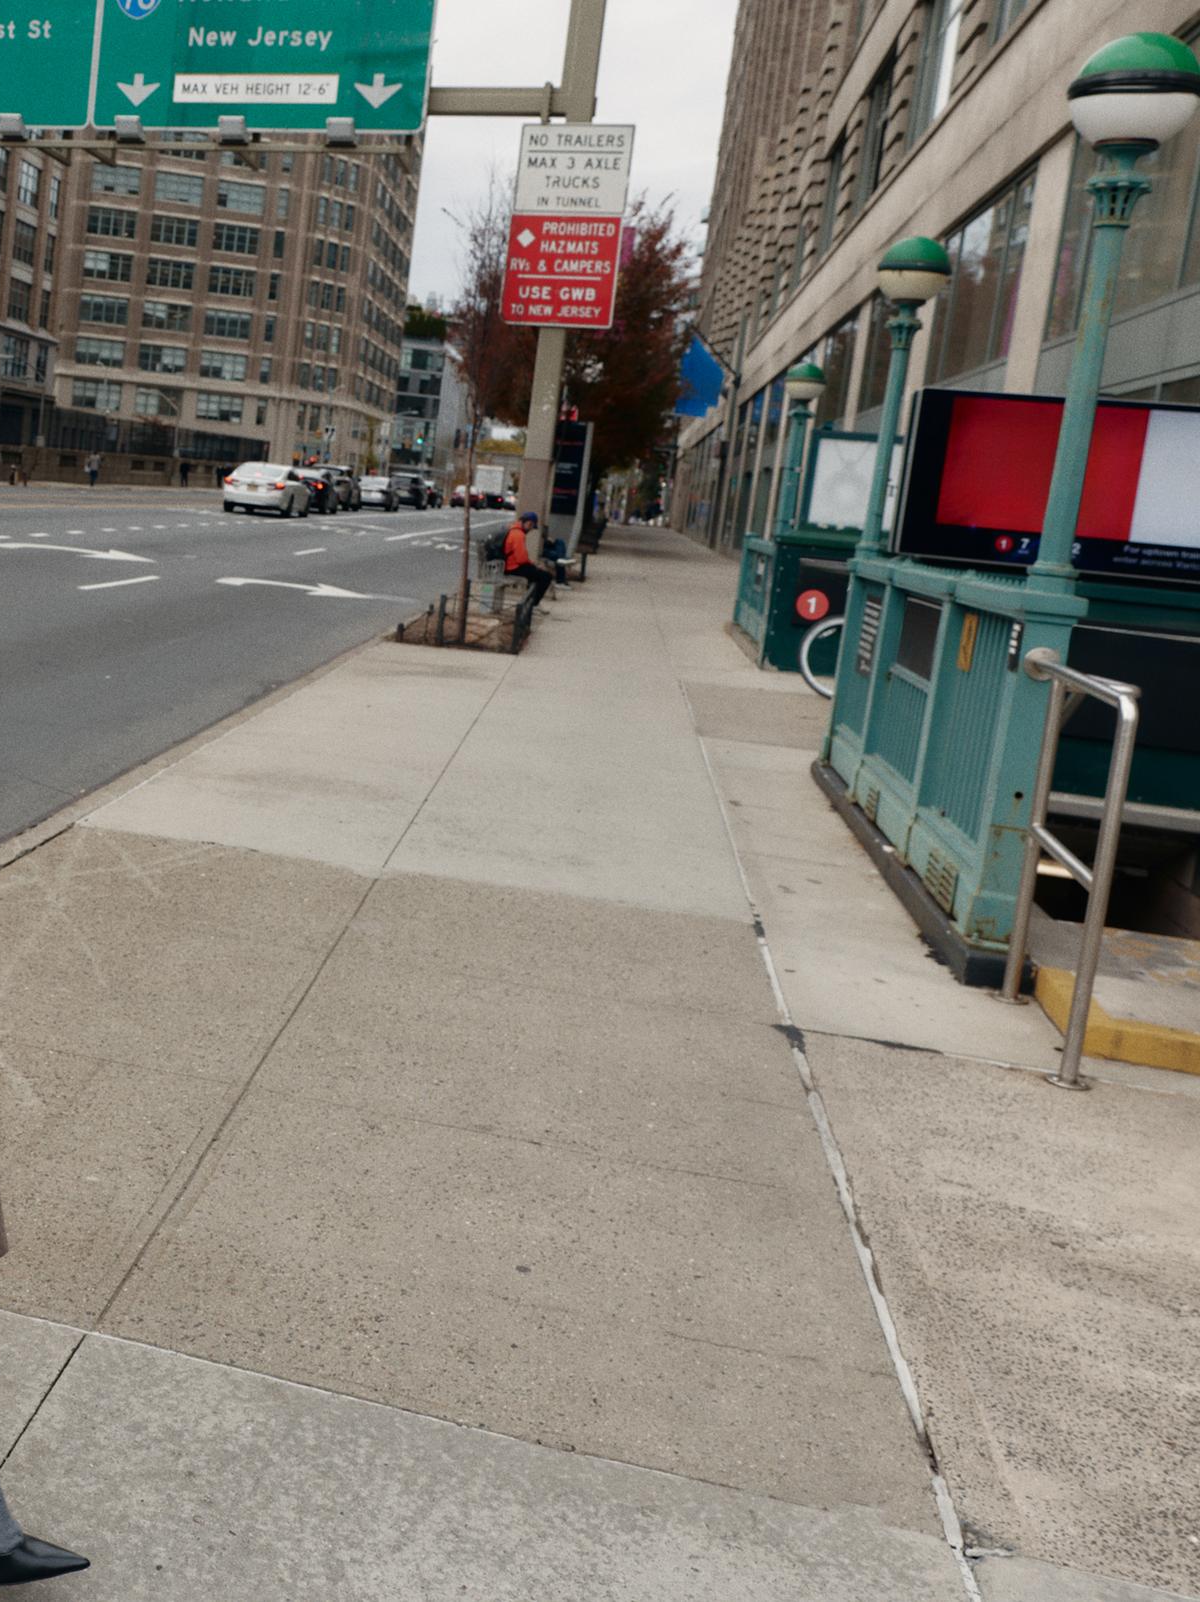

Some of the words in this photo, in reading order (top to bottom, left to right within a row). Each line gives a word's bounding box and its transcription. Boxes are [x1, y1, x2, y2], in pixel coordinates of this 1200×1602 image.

[27, 19, 52, 40] St
[188, 26, 237, 47] New
[247, 26, 333, 51] Jersey
[181, 83, 208, 94] MAX
[214, 83, 239, 95] VEH
[245, 83, 291, 96] HEIGHT
[529, 133, 549, 146] NO
[557, 134, 625, 148] TRAILERS
[527, 157, 557, 169] MAX
[567, 157, 576, 170] 3
[584, 157, 621, 171] AXLE
[545, 176, 600, 189] TRUCKS
[536, 196, 549, 207] IN
[555, 196, 600, 209] TUNNEL
[542, 221, 615, 237] PROHIBITED
[540, 240, 599, 255] HAZMATS
[510, 258, 530, 271] RVs
[537, 259, 547, 272] &
[554, 259, 611, 274] CAMPERS
[518, 285, 552, 299] USE
[559, 287, 596, 301] GWB
[511, 304, 524, 315] TO
[528, 305, 553, 317] NEW
[557, 306, 602, 319] JERSEY
[807, 596, 817, 614] 1
